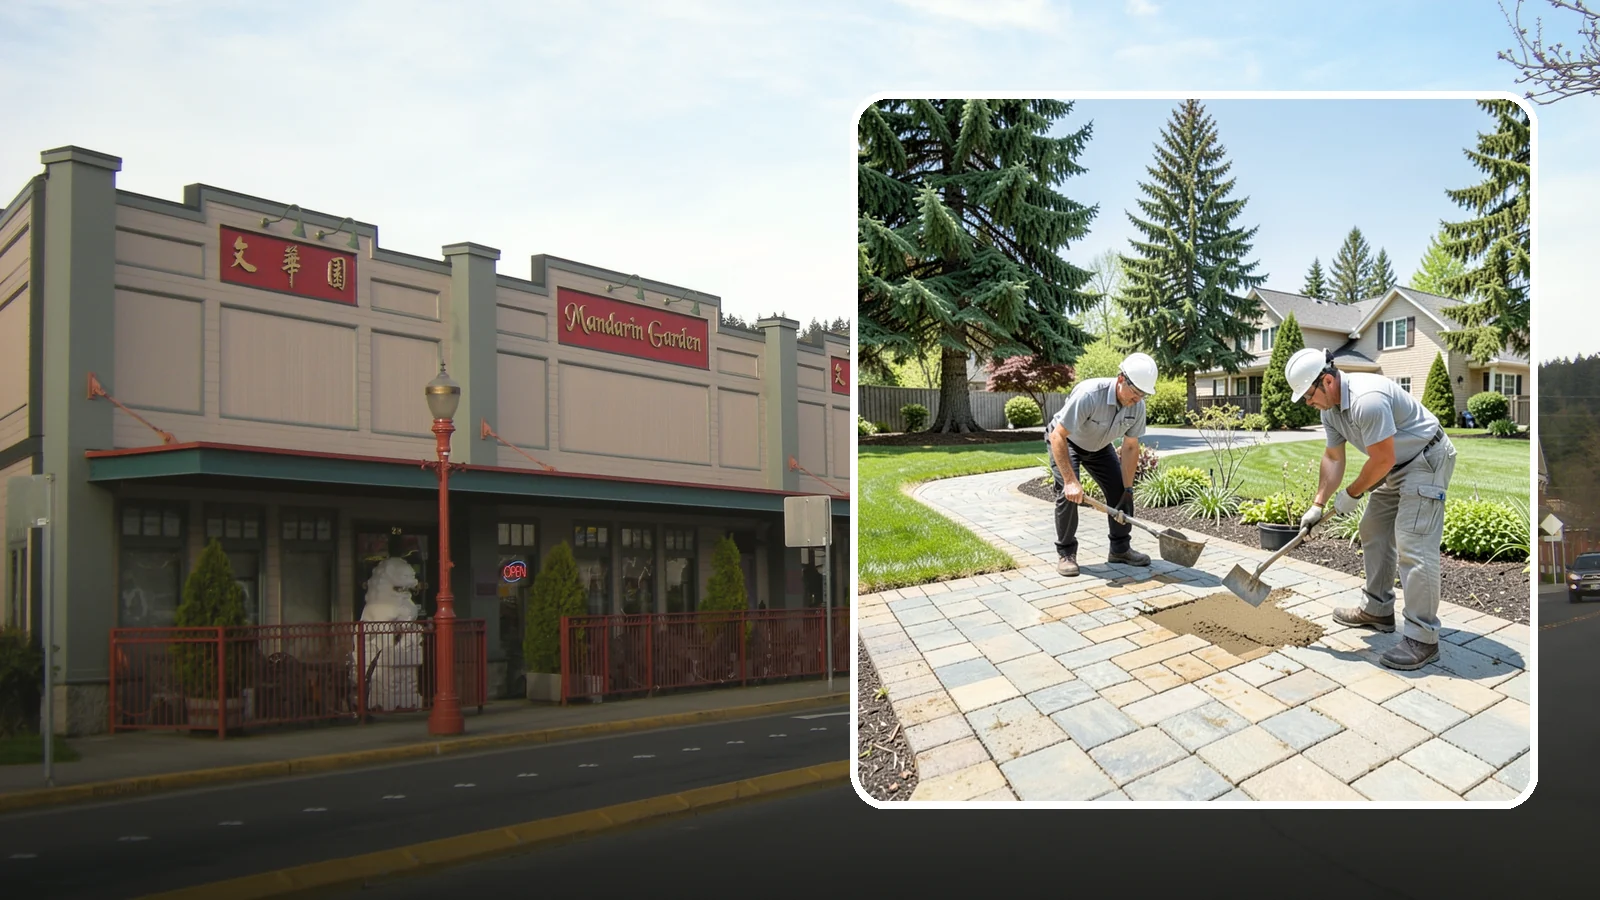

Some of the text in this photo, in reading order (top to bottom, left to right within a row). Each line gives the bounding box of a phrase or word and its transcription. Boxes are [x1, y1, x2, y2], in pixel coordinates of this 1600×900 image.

[231, 236, 346, 290] 文華園
[564, 302, 702, 352] Mandarin Garden
[503, 565, 527, 578] OPEN
